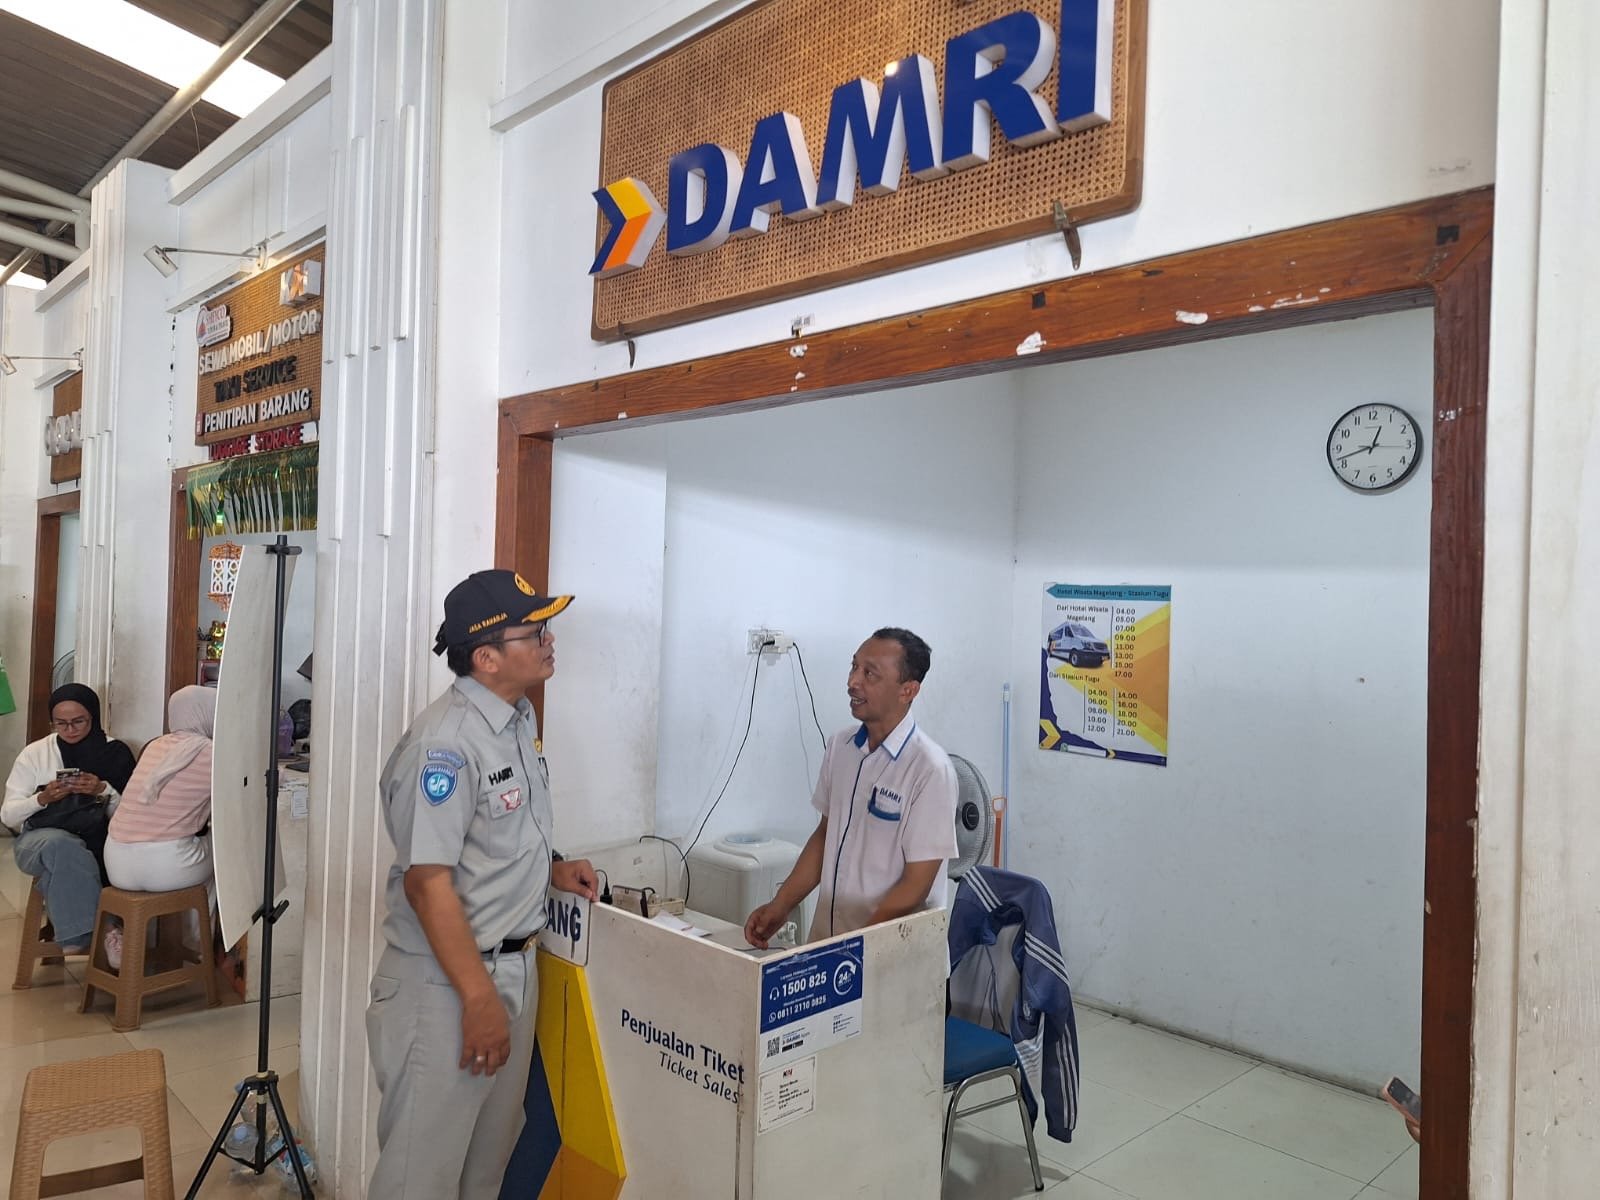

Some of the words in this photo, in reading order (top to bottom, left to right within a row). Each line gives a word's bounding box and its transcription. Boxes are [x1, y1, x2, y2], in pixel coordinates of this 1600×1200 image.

[666, 0, 1110, 257] DAMRI
[200, 345, 228, 375] SEWA
[242, 355, 298, 394] SERVICE
[204, 403, 258, 432] PENITIPAN
[260, 388, 311, 421] BARANG
[1354, 416, 1361, 426] 11
[1368, 411, 1378, 421] 12
[1341, 429, 1350, 439] 10
[1400, 424, 1407, 434] 2
[254, 423, 304, 452] STORAGE
[1336, 444, 1342, 453] 9
[1406, 440, 1412, 450] 3
[1341, 459, 1348, 469] 8
[1400, 456, 1406, 465] 4
[1354, 470, 1360, 480] 7
[1369, 473, 1376, 483] 6
[1386, 468, 1392, 478] 5
[1088, 605, 1109, 613] Wisata
[1067, 614, 1096, 623] Magelang
[1062, 672, 1084, 680] Stasiun
[1085, 674, 1100, 683] Tugu
[1118, 692, 1138, 700] 14.00
[1088, 716, 1107, 724] 10.00
[1088, 725, 1106, 733] 12.00
[1116, 728, 1136, 736] 21.00
[545, 898, 581, 942] ANG
[782, 978, 807, 997] 1500
[808, 971, 827, 988] 825
[777, 1006, 793, 1020] 0811
[794, 1002, 810, 1013] 2110
[621, 1008, 696, 1061] Penjualan
[700, 1044, 745, 1085] Tiket
[660, 1051, 698, 1085] Ticket
[703, 1074, 739, 1104] Sales
